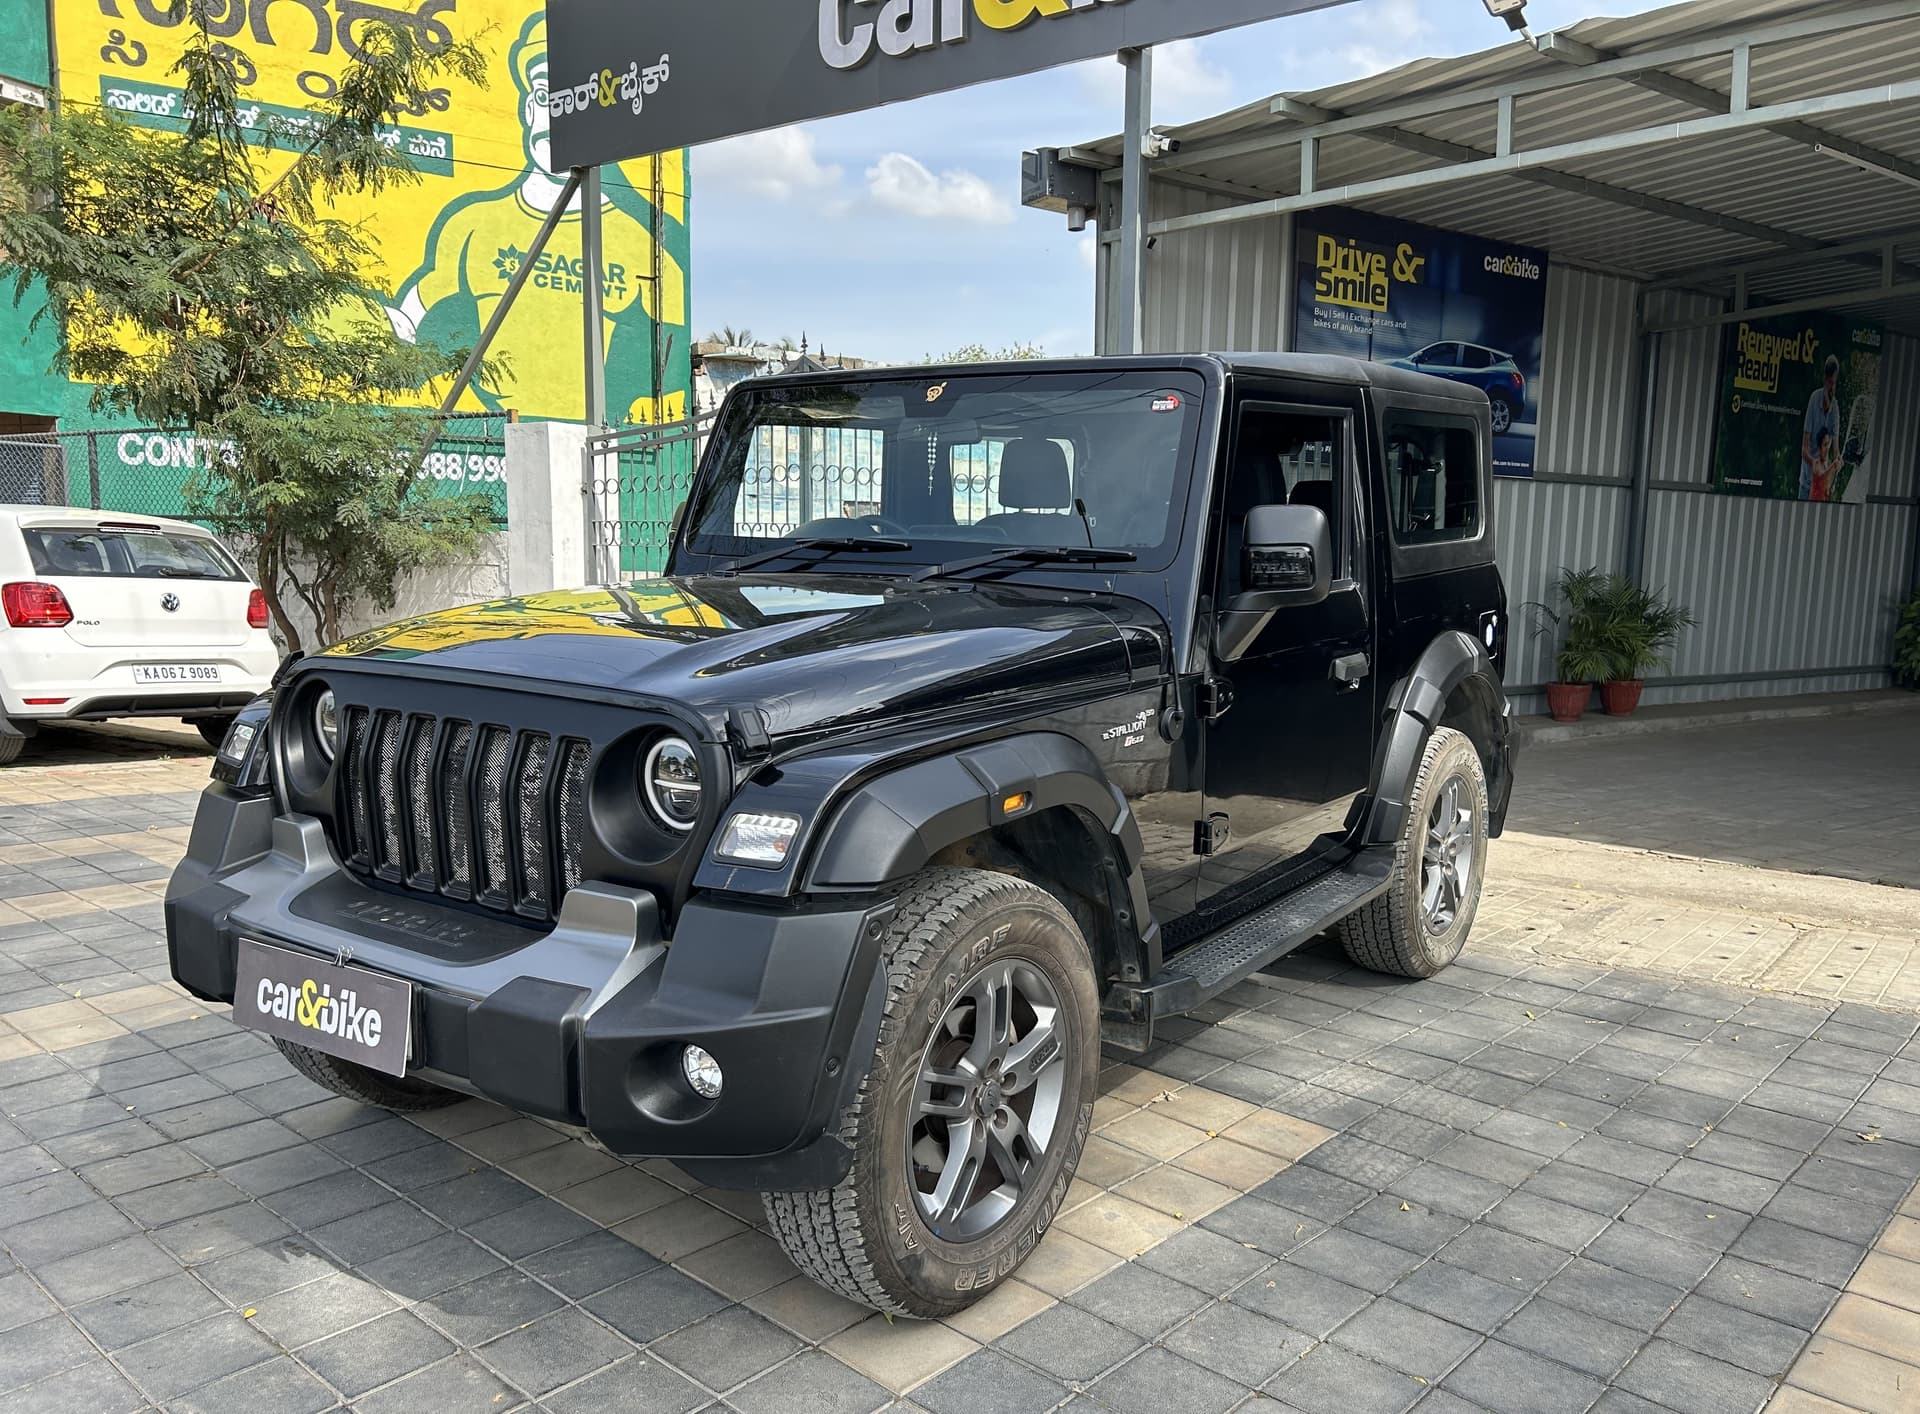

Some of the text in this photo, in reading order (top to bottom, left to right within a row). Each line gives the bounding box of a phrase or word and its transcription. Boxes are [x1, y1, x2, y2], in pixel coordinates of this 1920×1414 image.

[533, 251, 626, 285] SAGR
[1316, 234, 1425, 284] Drive &
[1483, 255, 1540, 280] car&bike
[533, 274, 627, 300] CEMNT
[1315, 266, 1387, 306] Smile
[1313, 318, 1331, 329] bikes
[1341, 322, 1353, 333] any
[1354, 325, 1373, 335] brand
[1314, 307, 1328, 319] Buy
[1333, 310, 1345, 319] Sell
[1350, 312, 1380, 326] Exchange
[1394, 320, 1407, 329] and
[1737, 321, 1820, 365] Renewed &
[117, 433, 244, 469] CONTA
[256, 977, 382, 1047] car&bike
